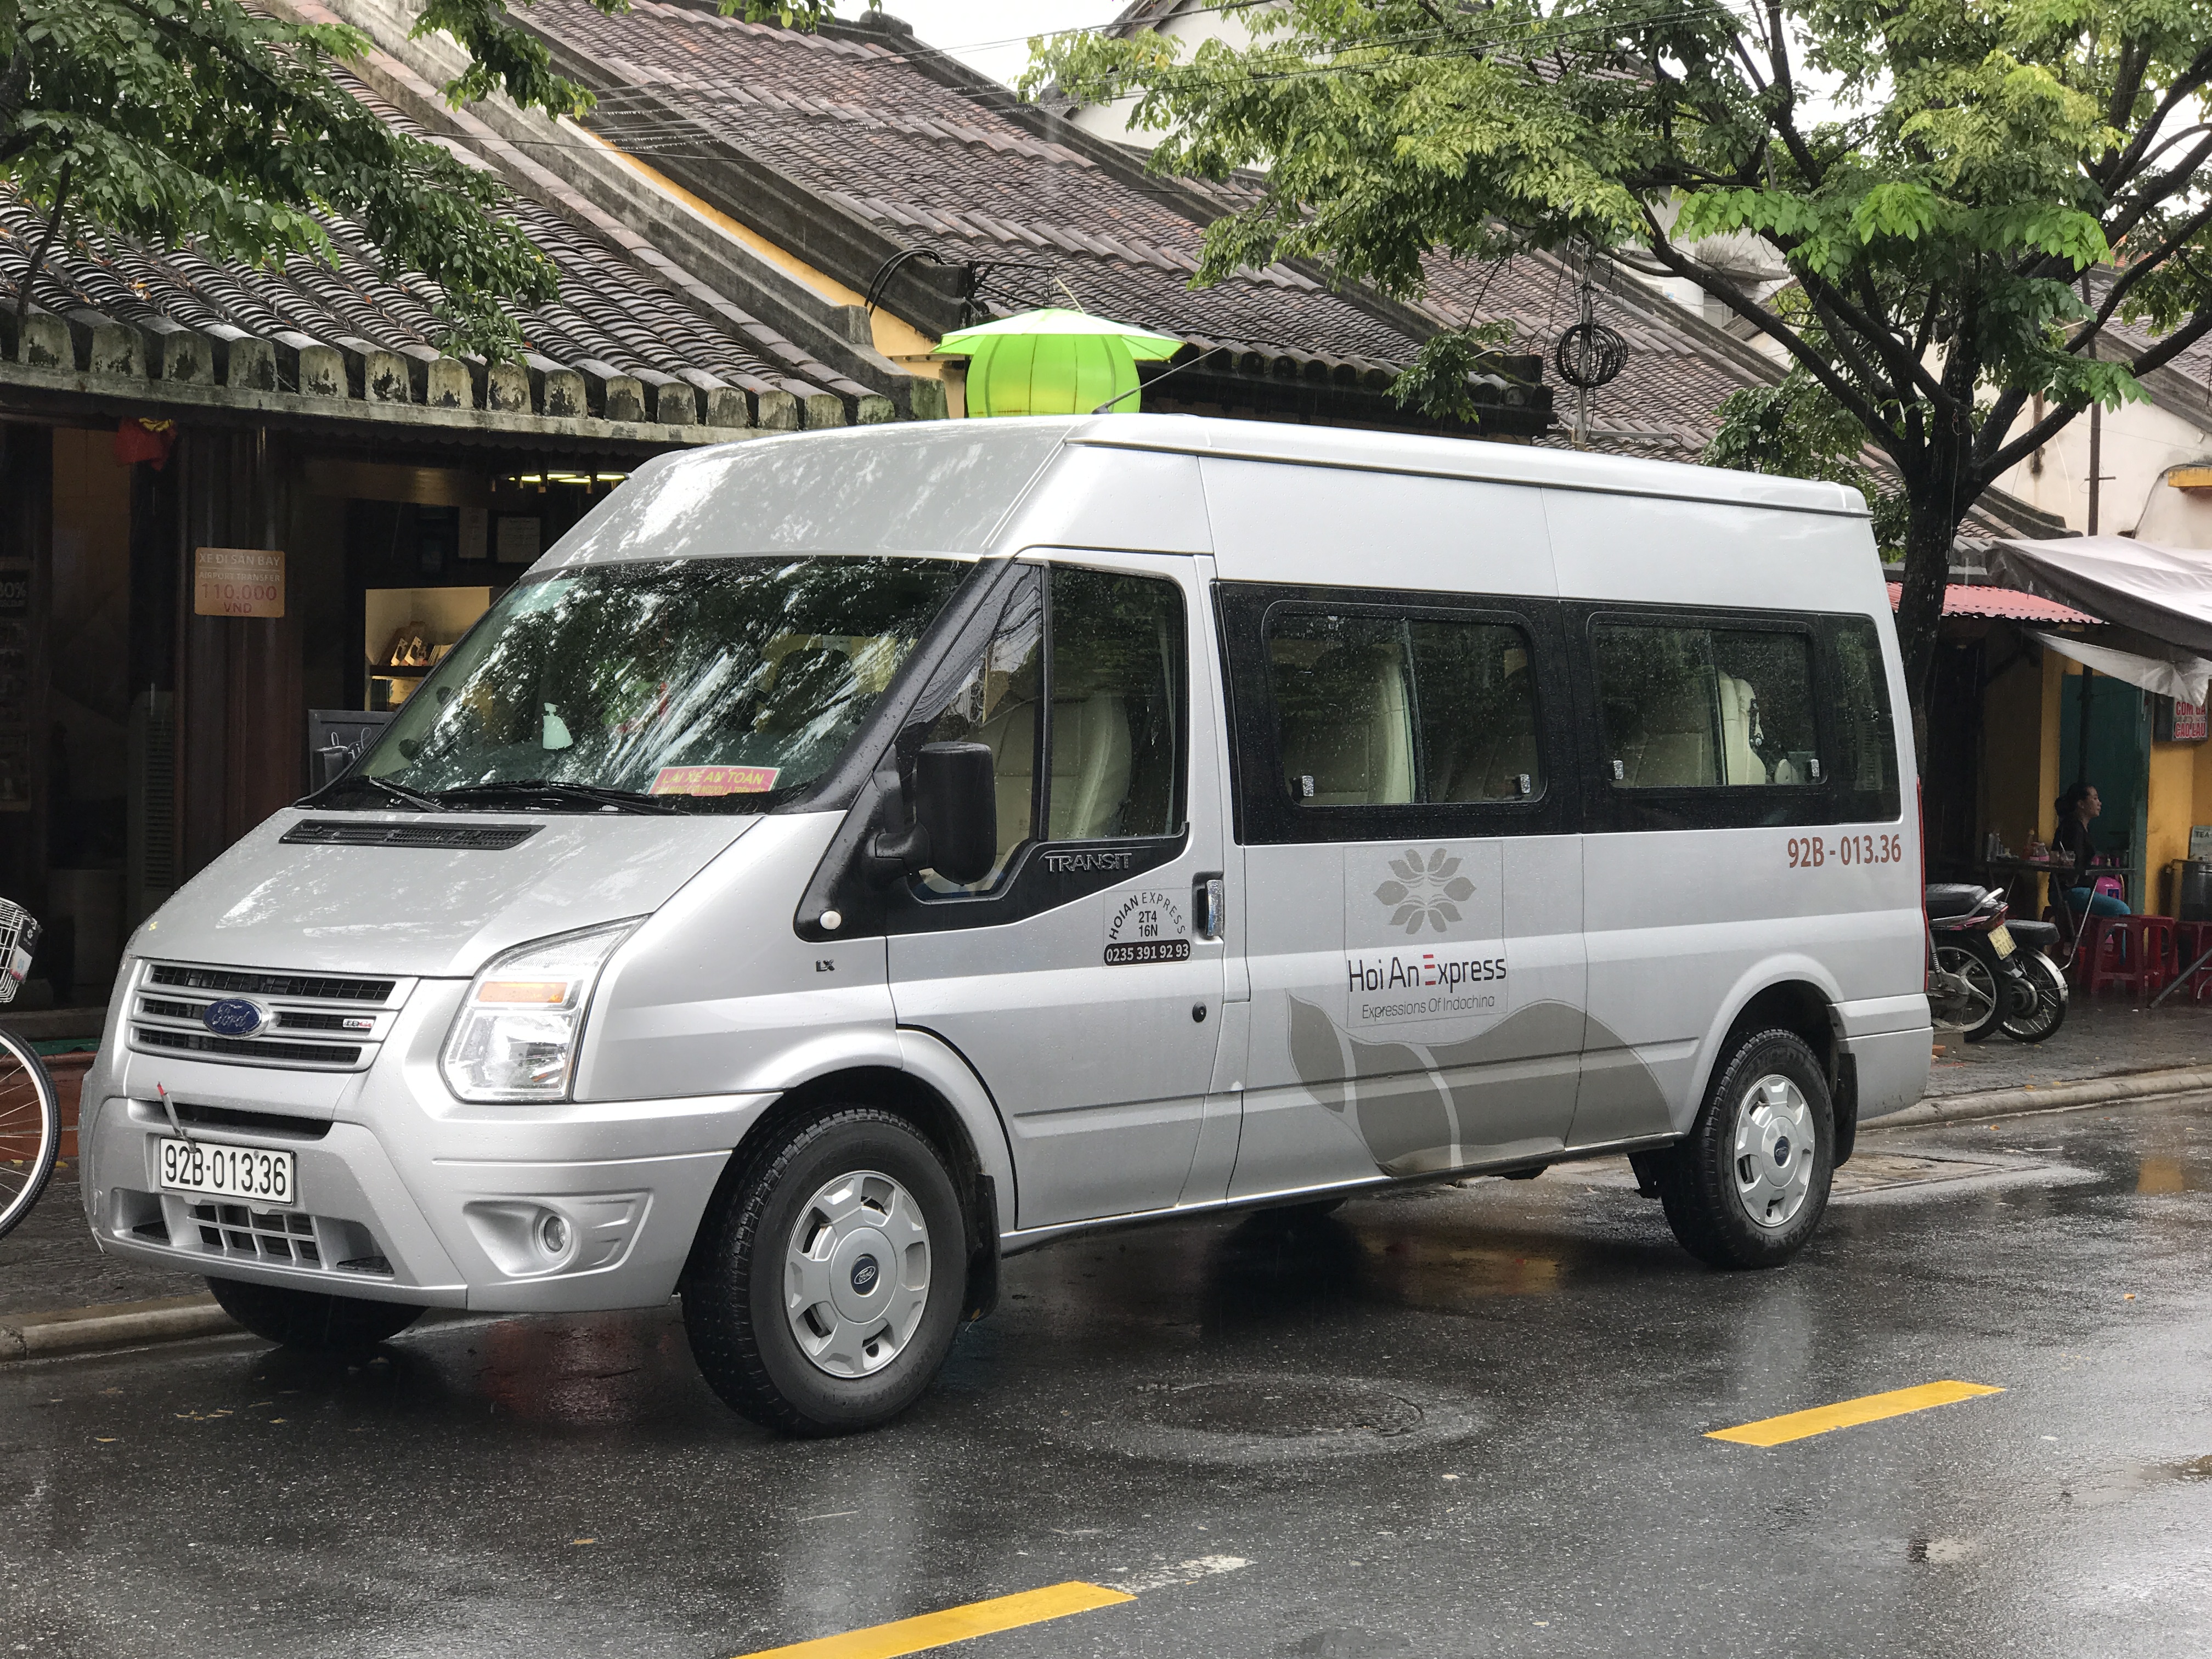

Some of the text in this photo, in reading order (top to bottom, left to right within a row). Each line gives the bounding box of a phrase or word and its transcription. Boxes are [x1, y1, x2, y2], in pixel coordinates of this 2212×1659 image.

[200, 553, 213, 563] XE
[258, 556, 280, 567] BAY
[199, 571, 280, 582] AIRPORT TRANSFER
[201, 583, 278, 601] 110.000
[223, 602, 252, 614] VND
[703, 771, 725, 783] AN
[1045, 853, 1132, 872] TRANSIT
[1138, 910, 1157, 923] 2T4
[1142, 891, 1186, 934] EXPRESS
[1138, 924, 1158, 937] 16N
[1106, 943, 1189, 962] 0235 391 92 93
[815, 959, 835, 972] LX
[1348, 953, 1507, 994] Hoi An Express
[212, 1002, 250, 1028] Ford
[1362, 994, 1495, 1022] Expressions Of Indochina
